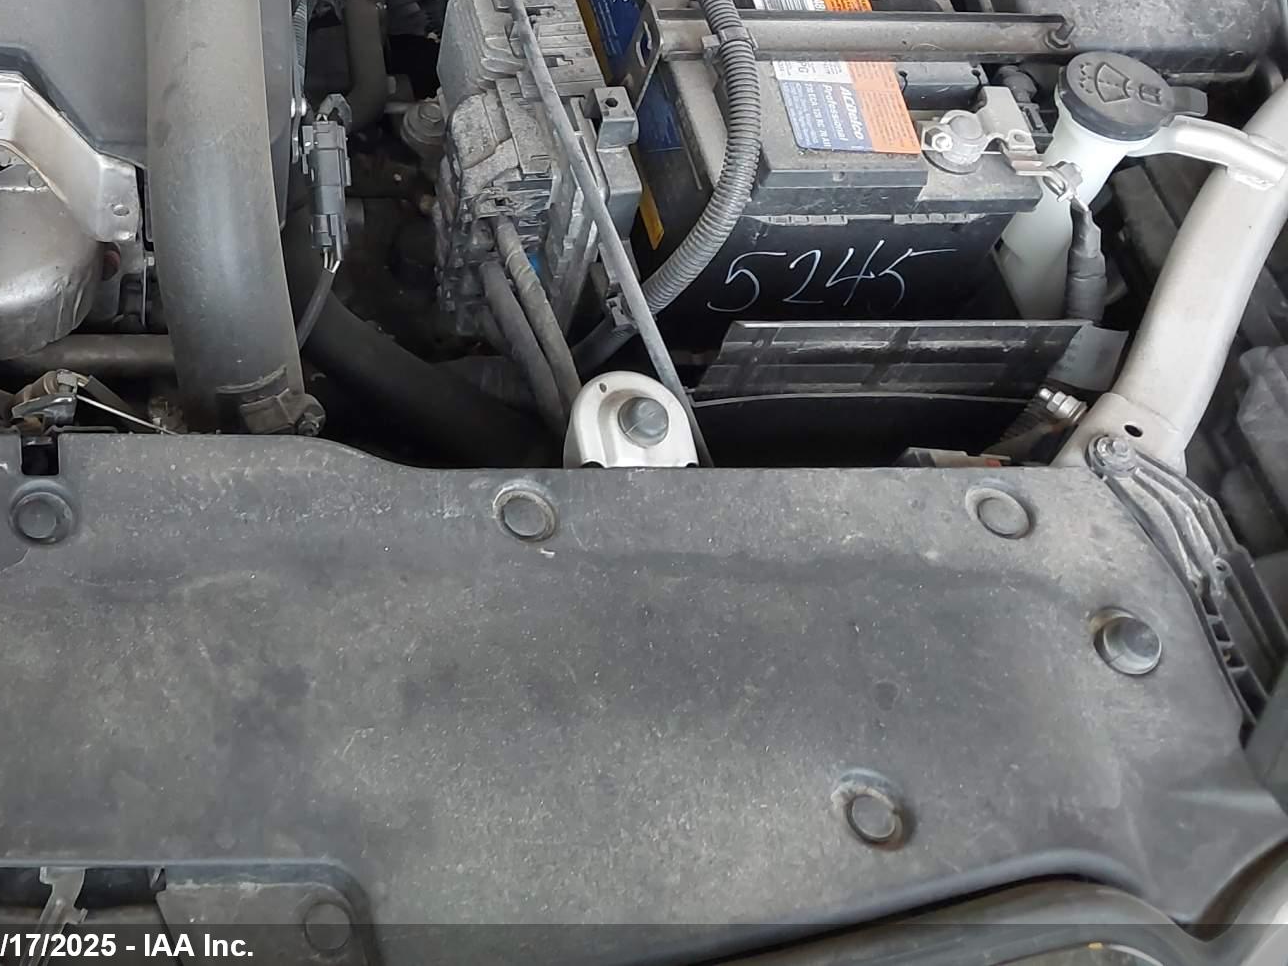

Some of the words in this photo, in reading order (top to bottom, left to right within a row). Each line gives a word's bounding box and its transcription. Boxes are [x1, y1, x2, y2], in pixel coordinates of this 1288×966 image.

[823, 84, 849, 141] Professional
[839, 85, 865, 140] ACDelco
[705, 239, 959, 313] 5245
